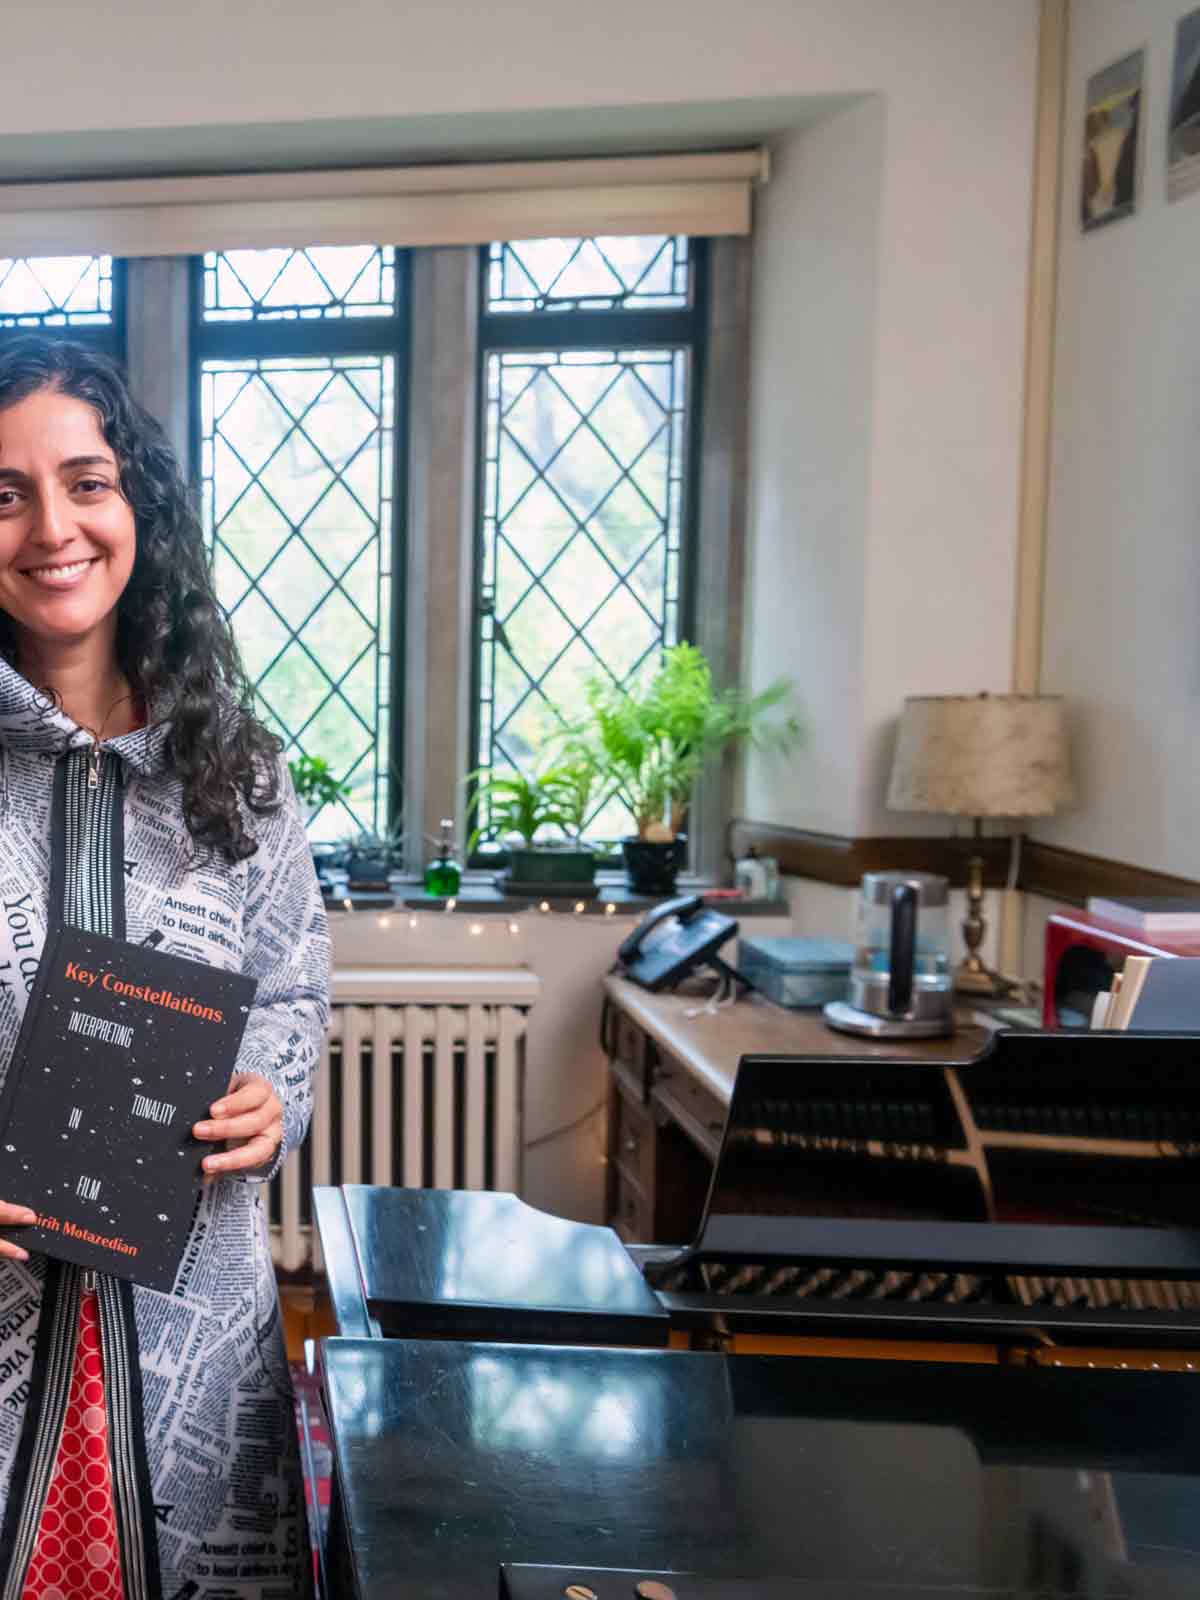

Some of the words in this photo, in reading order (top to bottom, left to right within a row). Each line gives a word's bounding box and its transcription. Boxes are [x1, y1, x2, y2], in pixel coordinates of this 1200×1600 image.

[3, 893, 36, 953] You
[164, 896, 206, 918] Ansett
[162, 915, 175, 927] to
[179, 918, 205, 936] lead
[64, 962, 99, 986] Key
[102, 973, 224, 1023] Constellations
[68, 1011, 134, 1048] INTERPRETING
[69, 1107, 83, 1129] IN
[131, 1094, 176, 1127] TONALITY
[76, 1175, 102, 1201] FILM
[175, 1222, 207, 1298] DESIGNS
